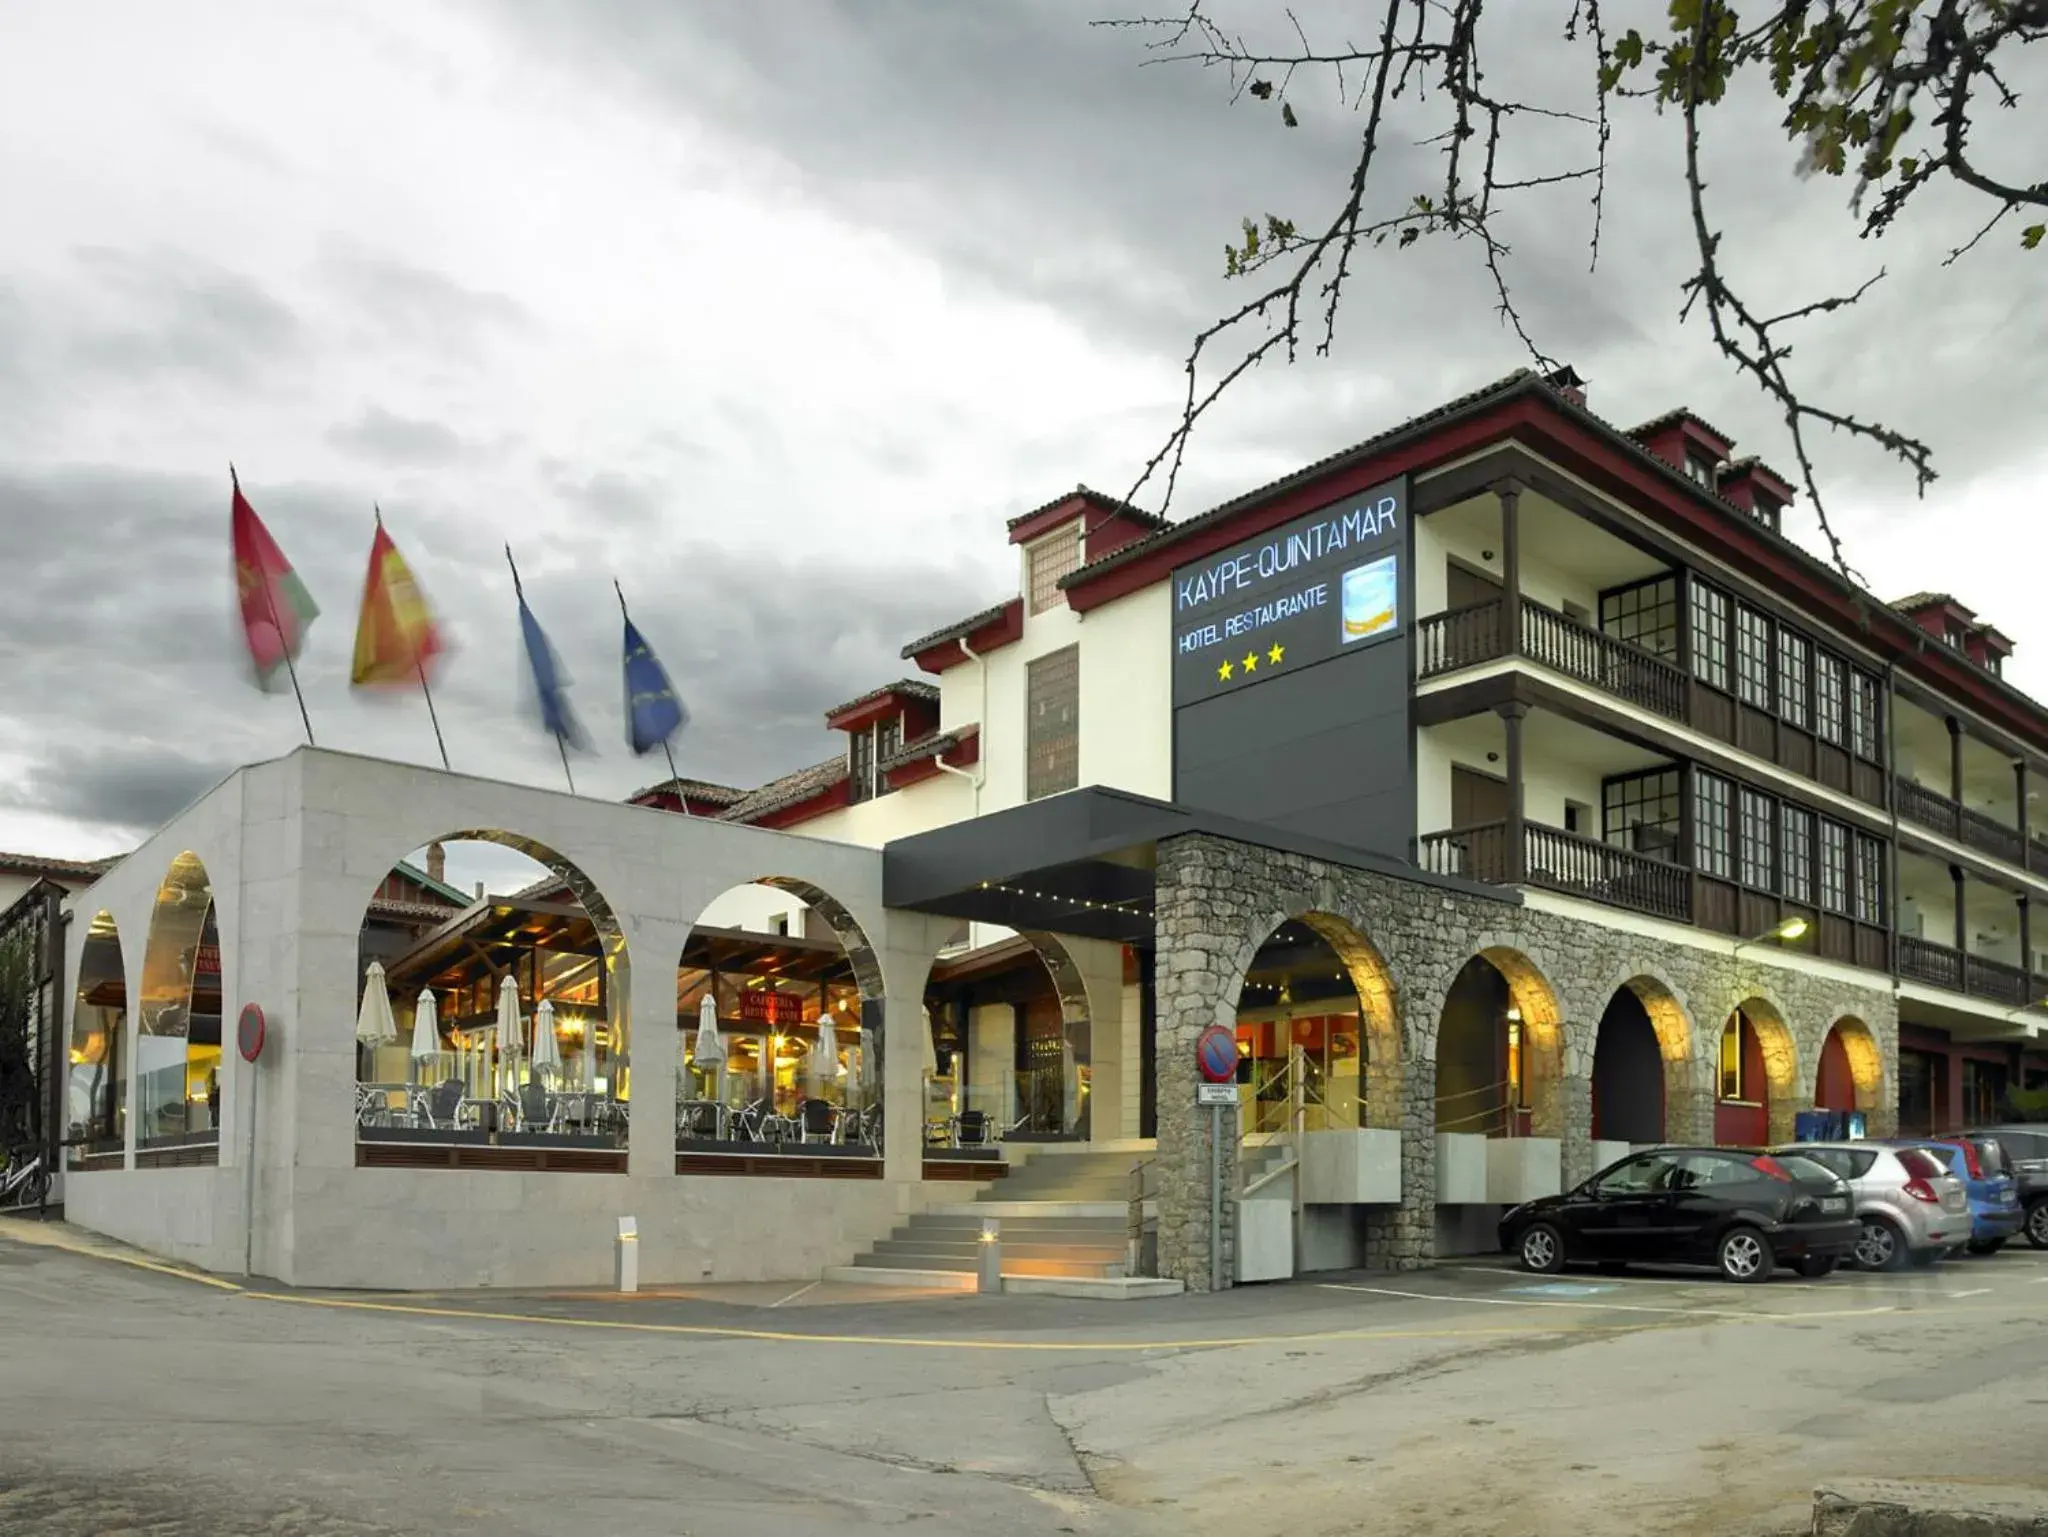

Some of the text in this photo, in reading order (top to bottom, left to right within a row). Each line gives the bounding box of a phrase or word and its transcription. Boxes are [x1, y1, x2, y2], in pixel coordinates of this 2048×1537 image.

[1178, 496, 1396, 612] KAYPE-QUINTAMAR
[1178, 583, 1328, 655] HOTEL RESTAURANTE
